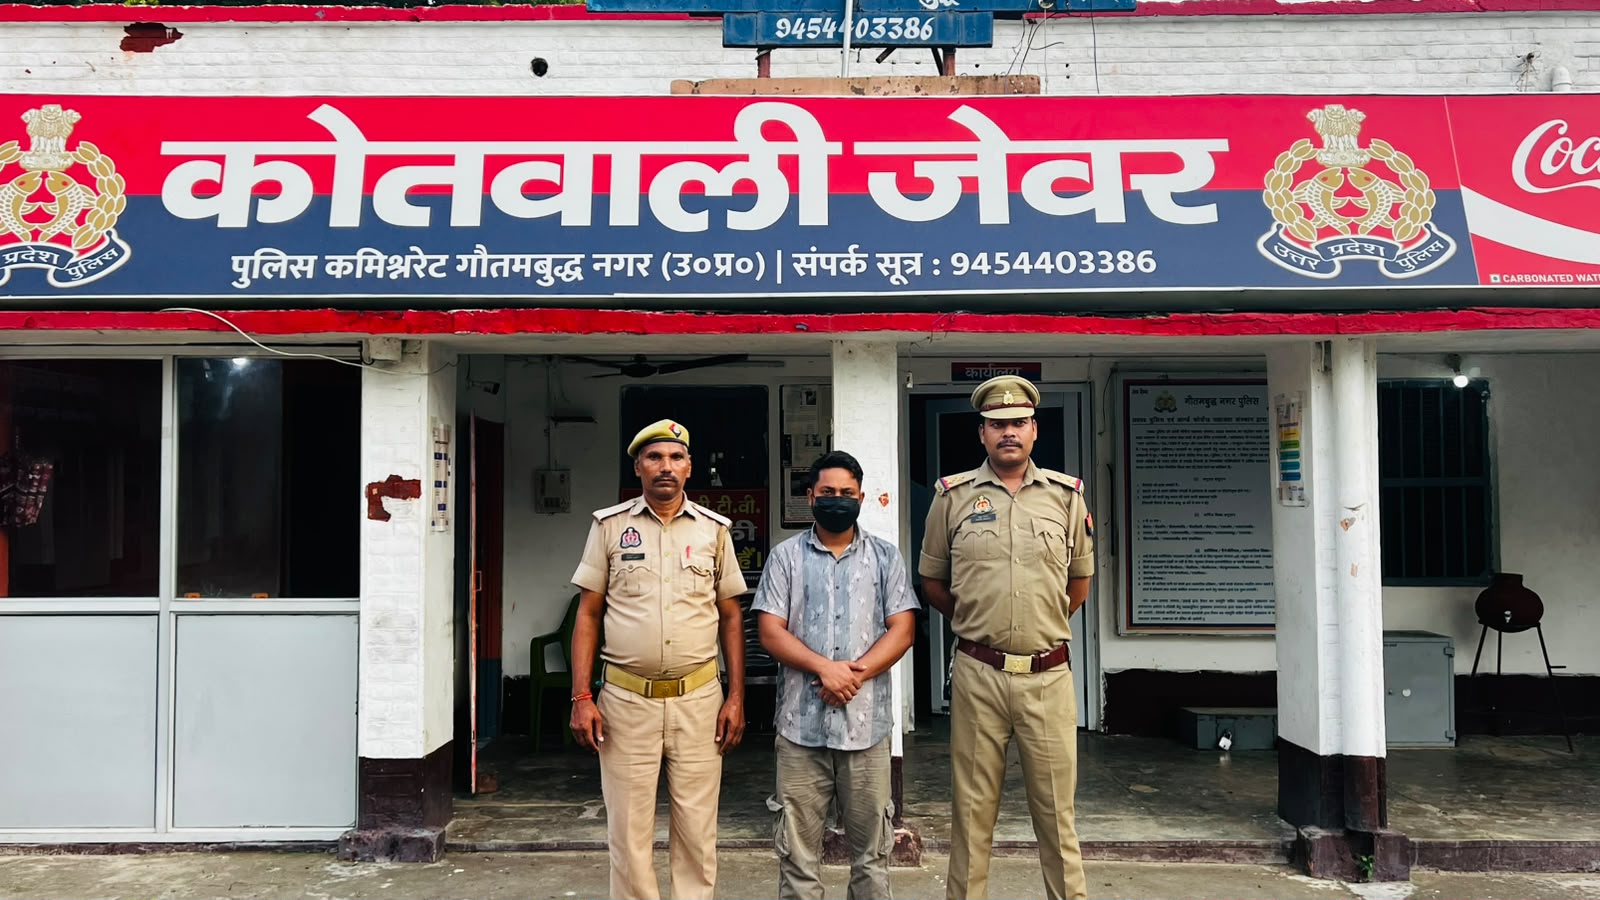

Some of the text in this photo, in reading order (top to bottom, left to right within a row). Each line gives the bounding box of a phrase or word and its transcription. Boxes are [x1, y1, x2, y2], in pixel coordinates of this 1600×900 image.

[160, 102, 1230, 233] कोतवाली जेवर
[1511, 118, 1600, 194] Coc
[2, 246, 119, 280] प्रदेश पुलिस
[231, 247, 318, 289] पुलिस
[324, 245, 449, 280] कमिश्नरेट
[455, 243, 586, 287] गौतमबुद्ध
[592, 253, 654, 278] नगर
[791, 244, 869, 277] संपर्क
[875, 252, 924, 286] सूत्र
[950, 249, 1158, 276] 9454403386
[1273, 238, 1445, 273] उत्तर प्रदेश पुलिस
[1502, 274, 1574, 283] CARBONATED
[1238, 394, 1260, 408] पुलिस
